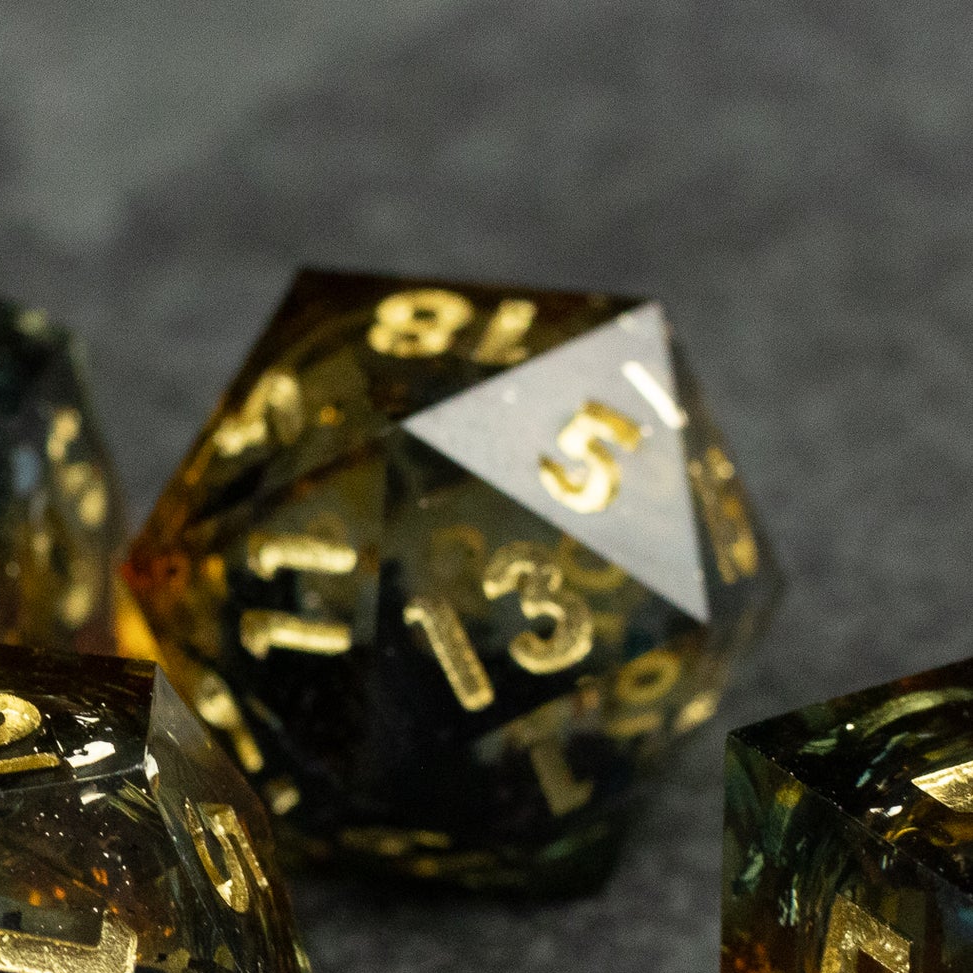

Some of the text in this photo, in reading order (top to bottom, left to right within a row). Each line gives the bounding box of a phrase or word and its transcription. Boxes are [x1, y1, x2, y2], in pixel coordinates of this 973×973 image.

[538, 399, 642, 514] 5
[241, 533, 357, 658] 11
[403, 540, 594, 713] 13
